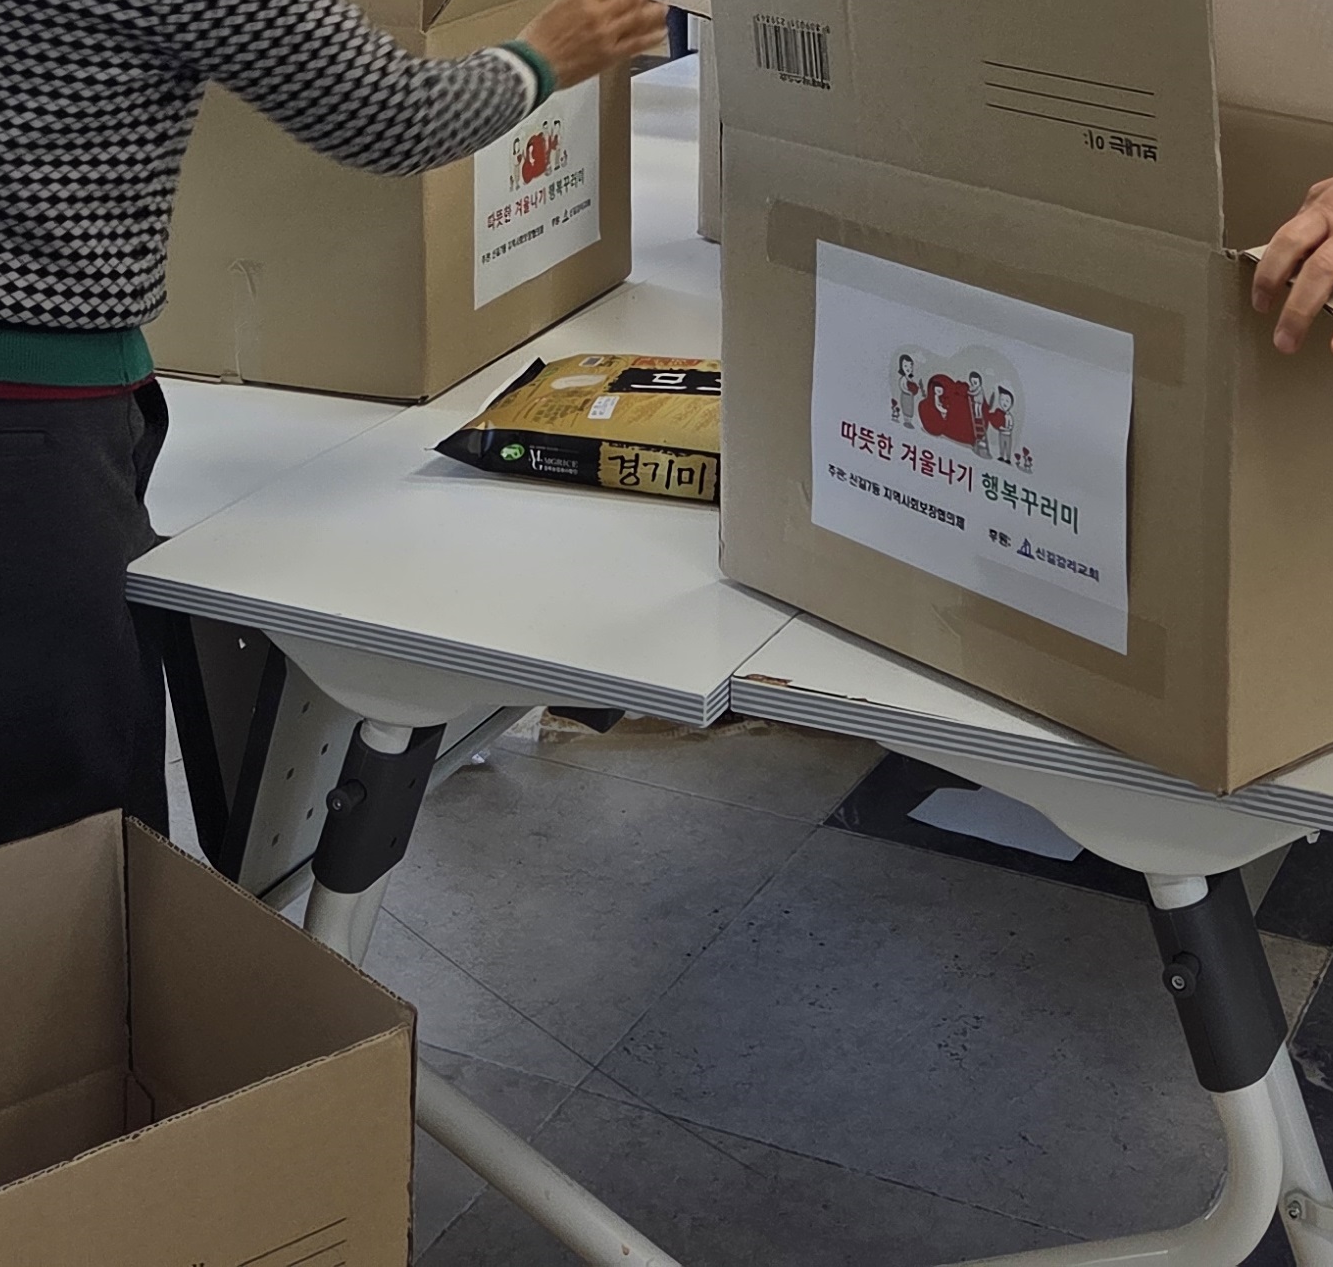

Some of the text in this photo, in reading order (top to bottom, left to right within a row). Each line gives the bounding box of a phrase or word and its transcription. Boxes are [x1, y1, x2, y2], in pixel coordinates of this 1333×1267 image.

[1108, 136, 1158, 162] 보내는
[487, 204, 512, 231] 따뜻한
[514, 187, 546, 217] 겨울나기
[608, 452, 707, 495] 경기미
[827, 463, 847, 481] 주관:
[840, 420, 1079, 535] 따뜻한 겨울나기 행복꾸러미
